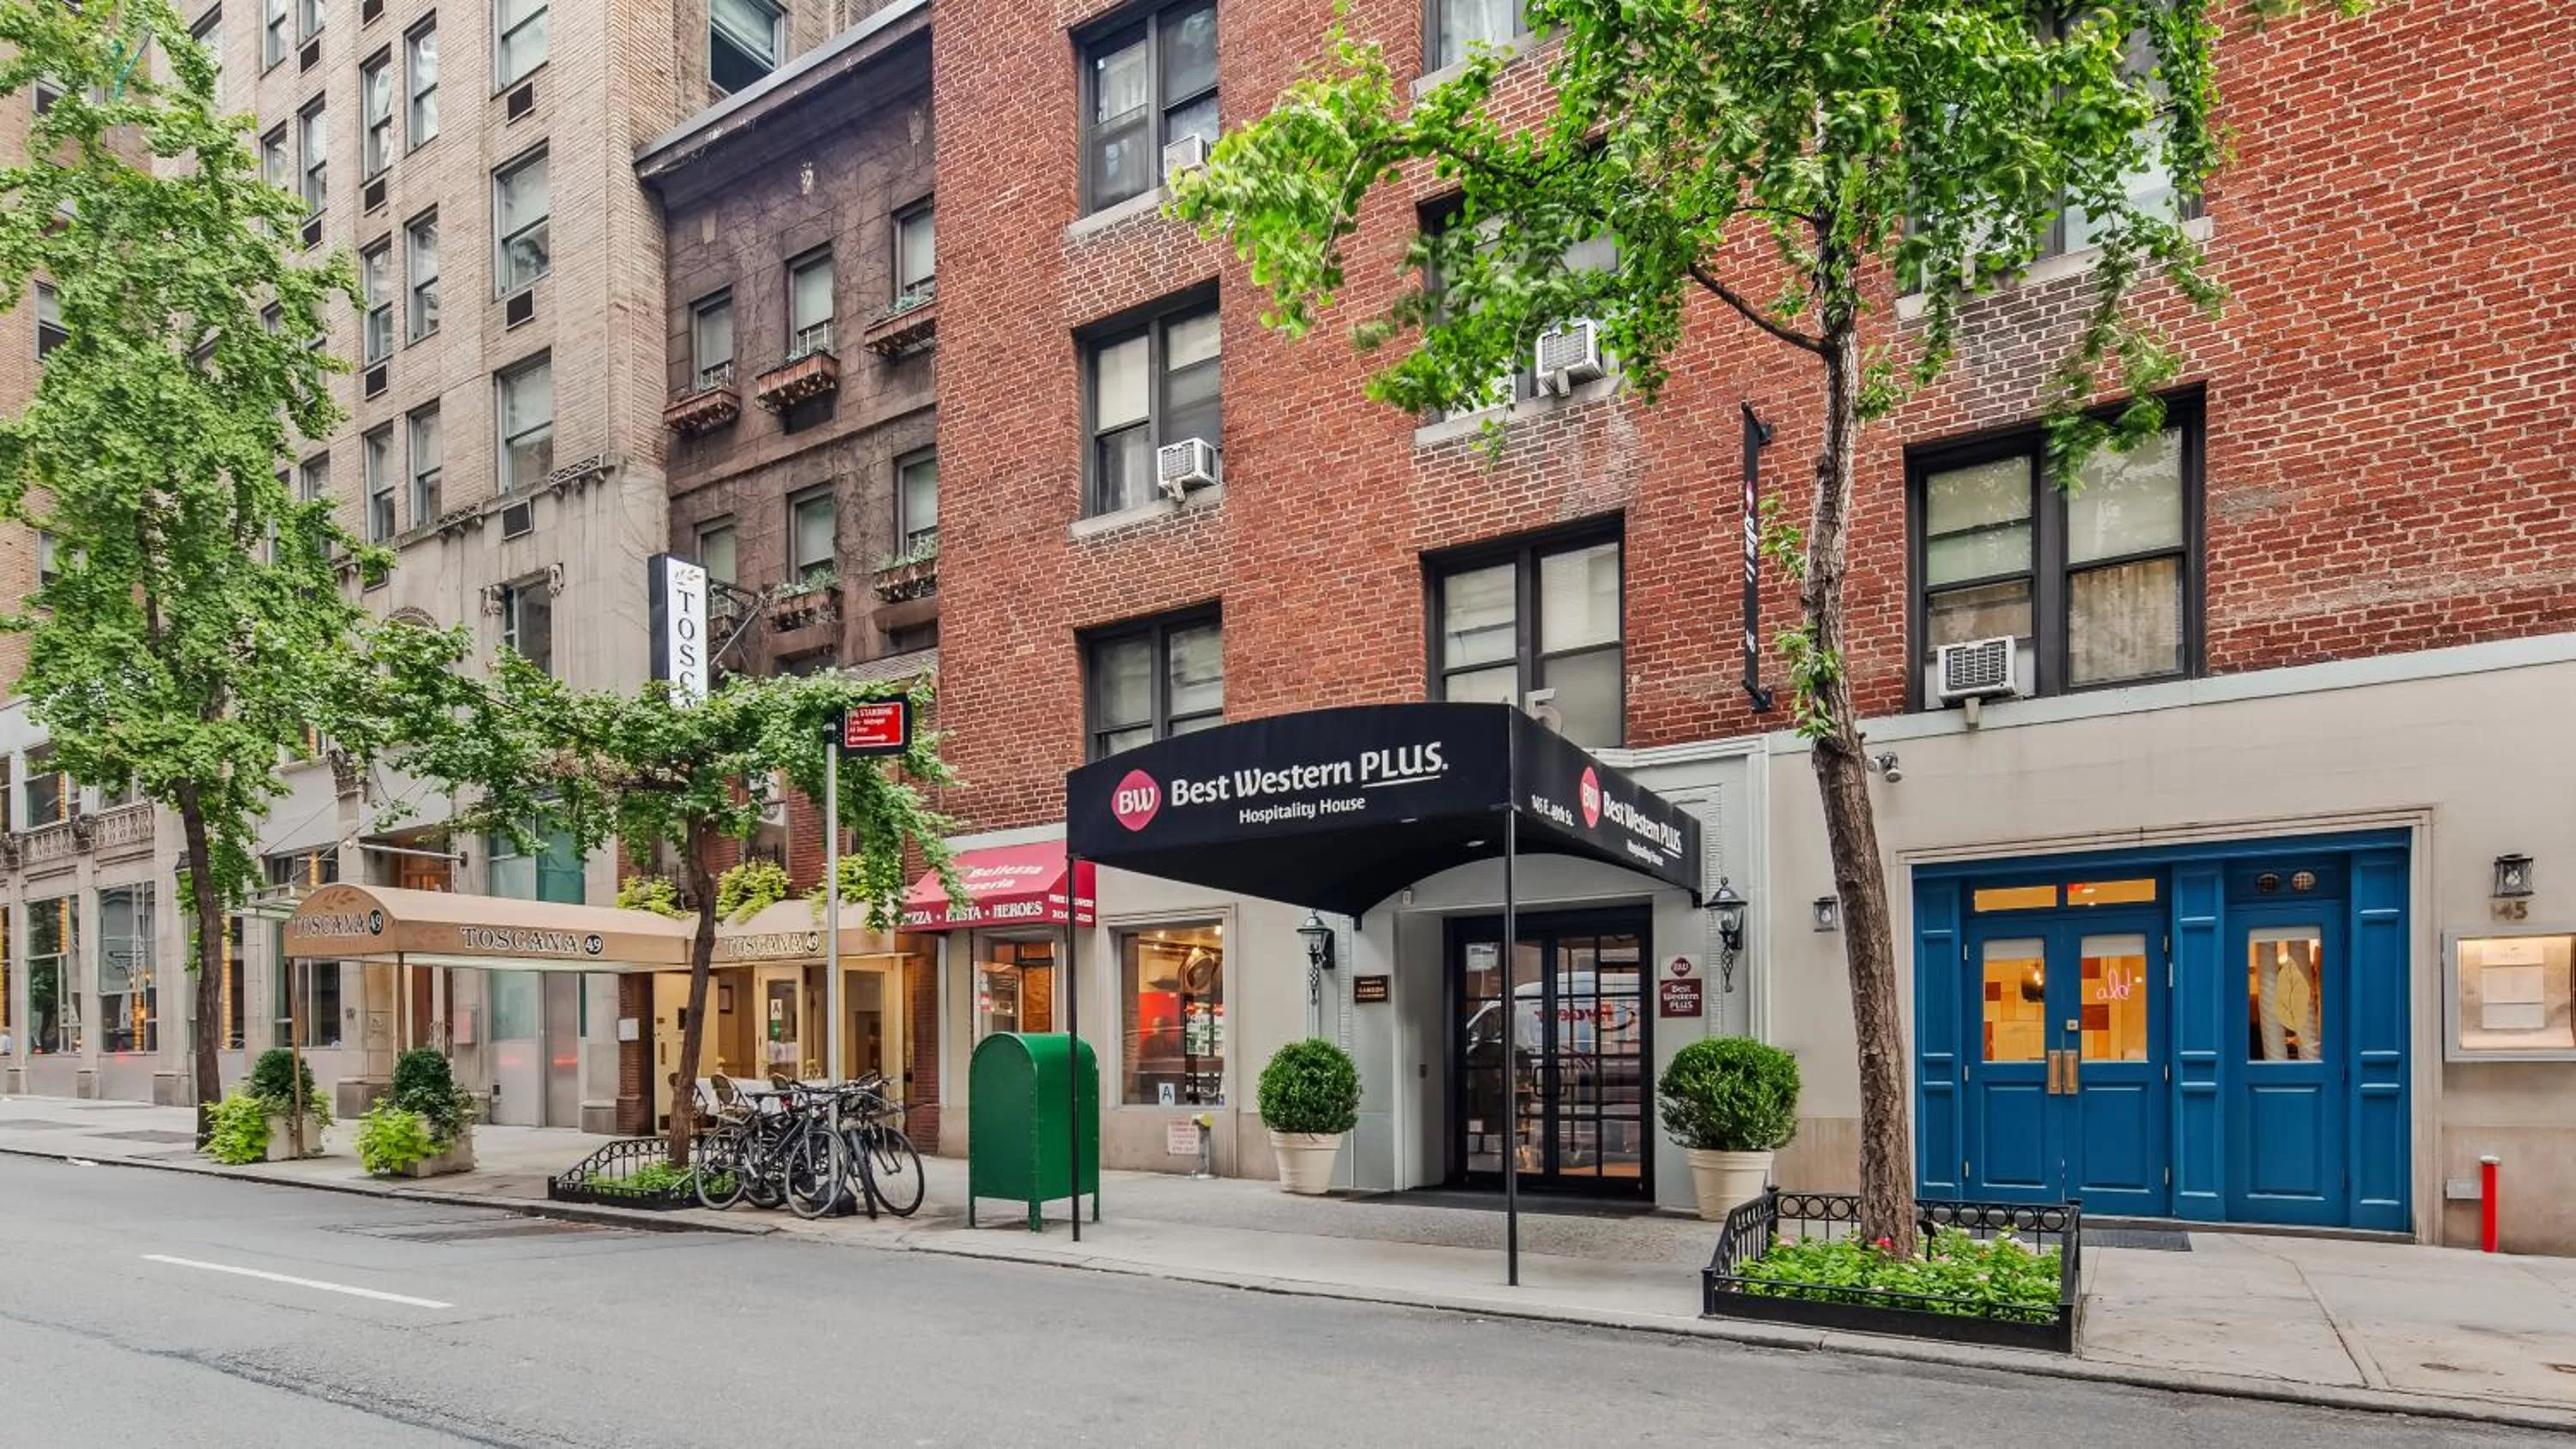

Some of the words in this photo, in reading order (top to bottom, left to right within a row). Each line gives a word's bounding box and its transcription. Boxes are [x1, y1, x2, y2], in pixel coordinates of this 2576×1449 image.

[1171, 775, 1230, 807] Best
[1234, 761, 1353, 798] Western
[1118, 787, 1155, 815] BW
[1238, 802, 1316, 825] Hospitality
[1320, 797, 1366, 815] House
[1603, 791, 1625, 824] Best
[1625, 803, 1660, 843] Western
[993, 901, 1043, 919] HEROES
[295, 912, 368, 937] TOSCANA
[370, 912, 383, 933] 49
[459, 926, 580, 955] TOSCANA
[585, 937, 603, 954] 49
[725, 933, 804, 957] TOSCANA
[1162, 1084, 1173, 1100] A
